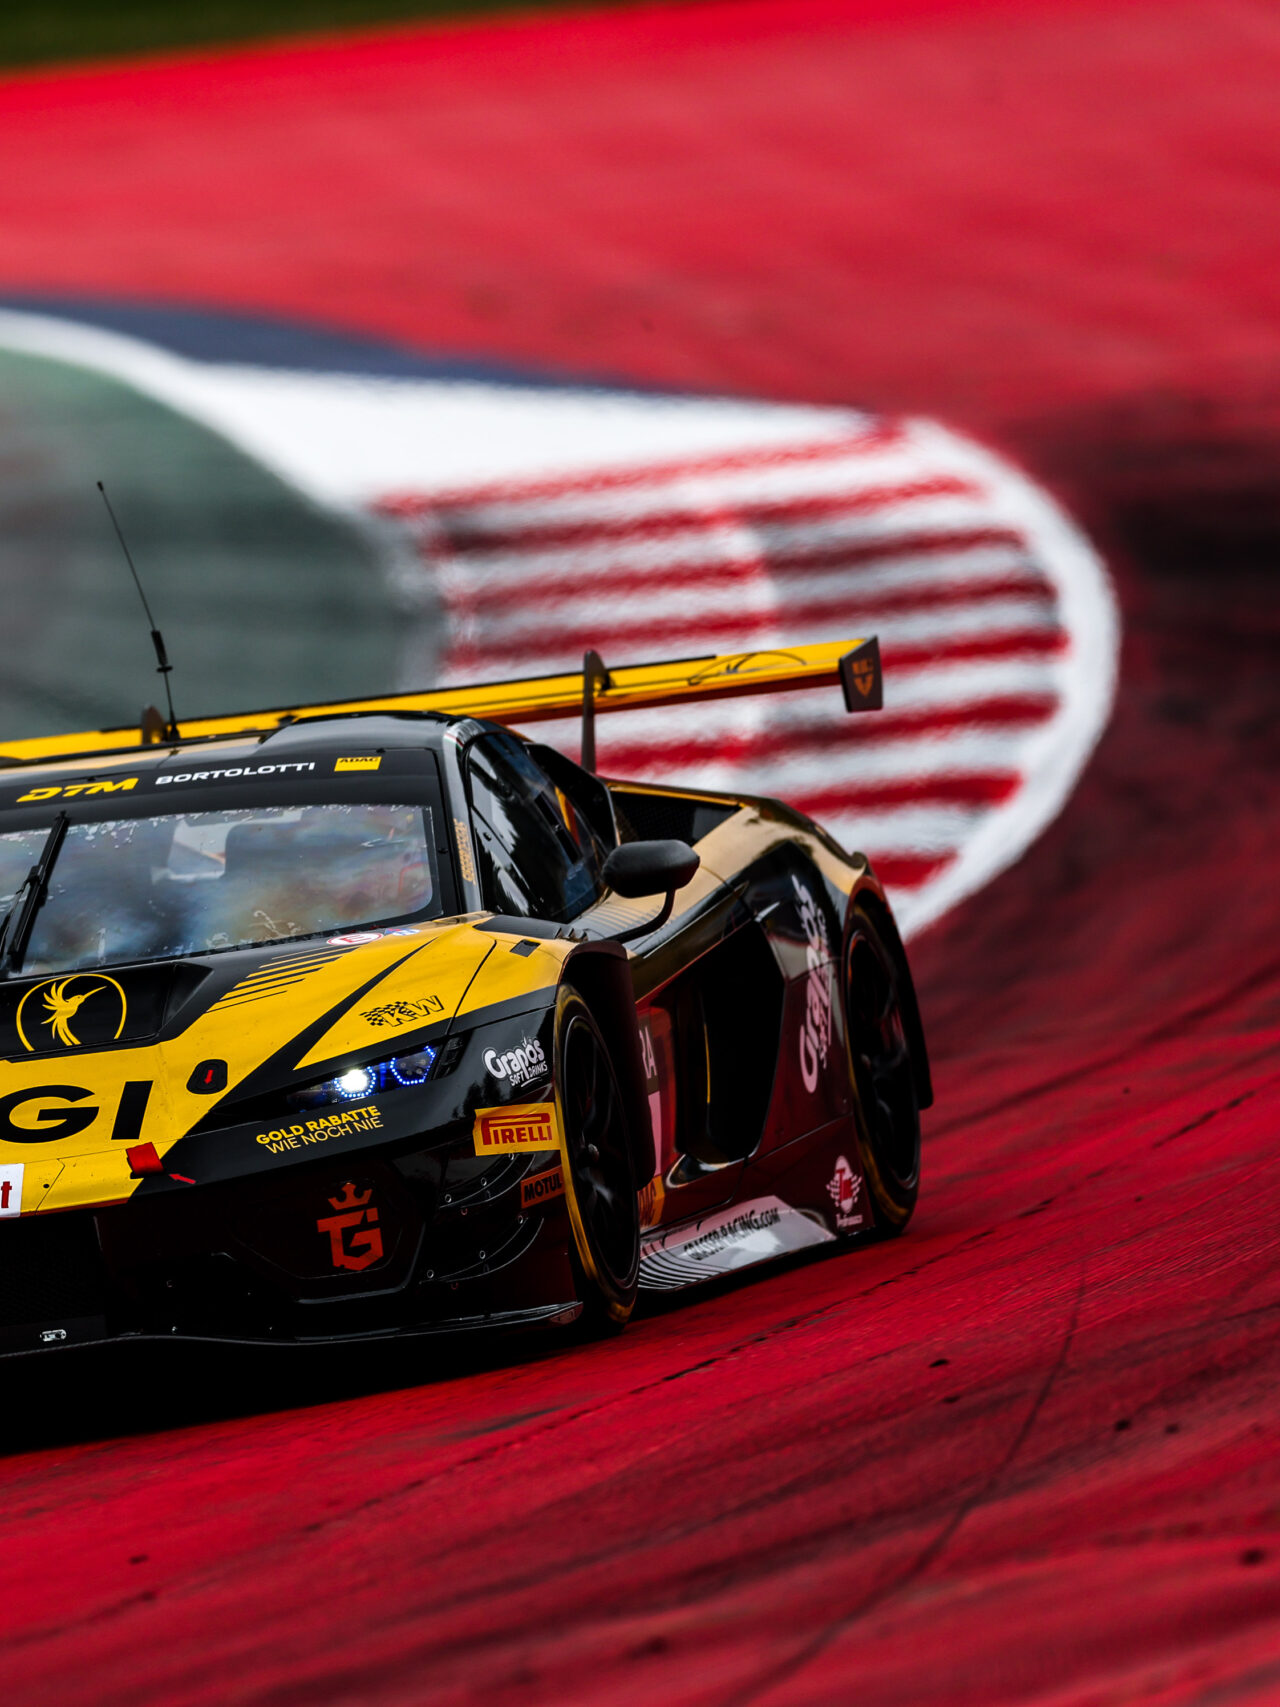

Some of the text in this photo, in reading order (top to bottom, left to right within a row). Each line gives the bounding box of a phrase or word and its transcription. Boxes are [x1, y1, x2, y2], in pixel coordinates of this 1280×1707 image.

[16, 762, 315, 802] DTM BORTOLOTTI
[484, 1038, 545, 1080] Grapos
[256, 1105, 381, 1144] GOLD RABATTE
[265, 1117, 384, 1154] WIE NOCH NIE
[481, 1113, 553, 1145] PIRELLI
[524, 1173, 562, 1203] MOTUL
